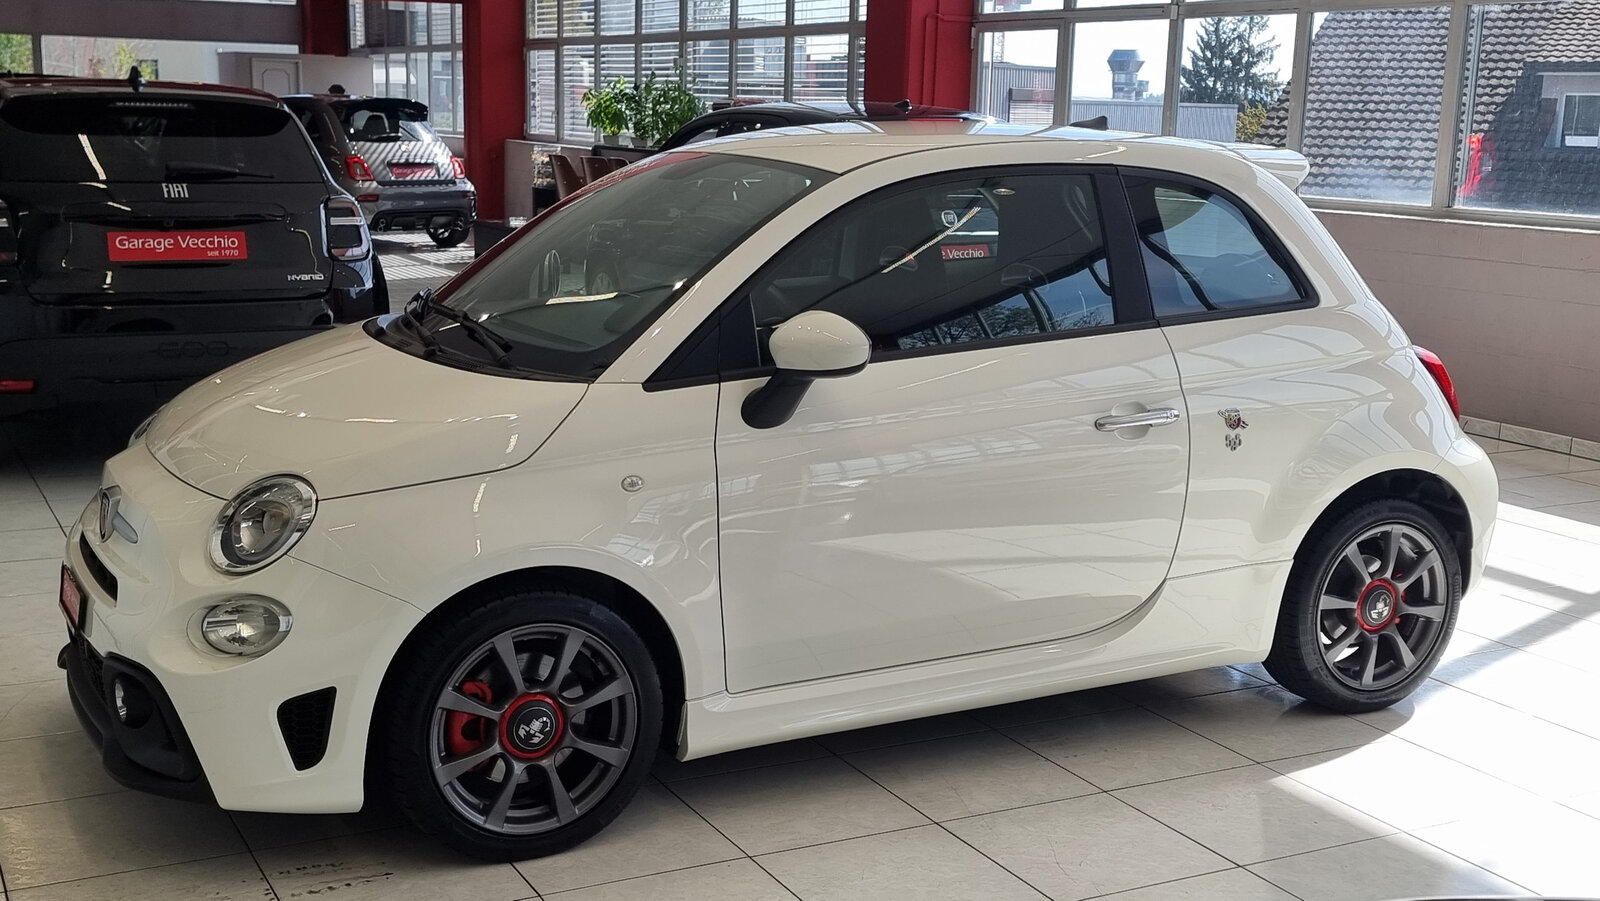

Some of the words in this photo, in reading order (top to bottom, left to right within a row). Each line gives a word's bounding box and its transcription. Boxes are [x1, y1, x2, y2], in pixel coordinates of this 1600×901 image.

[162, 183, 189, 198] FIAT
[115, 236, 174, 252] Garage
[178, 235, 239, 248] Vecchio
[947, 248, 985, 259] Vecchio
